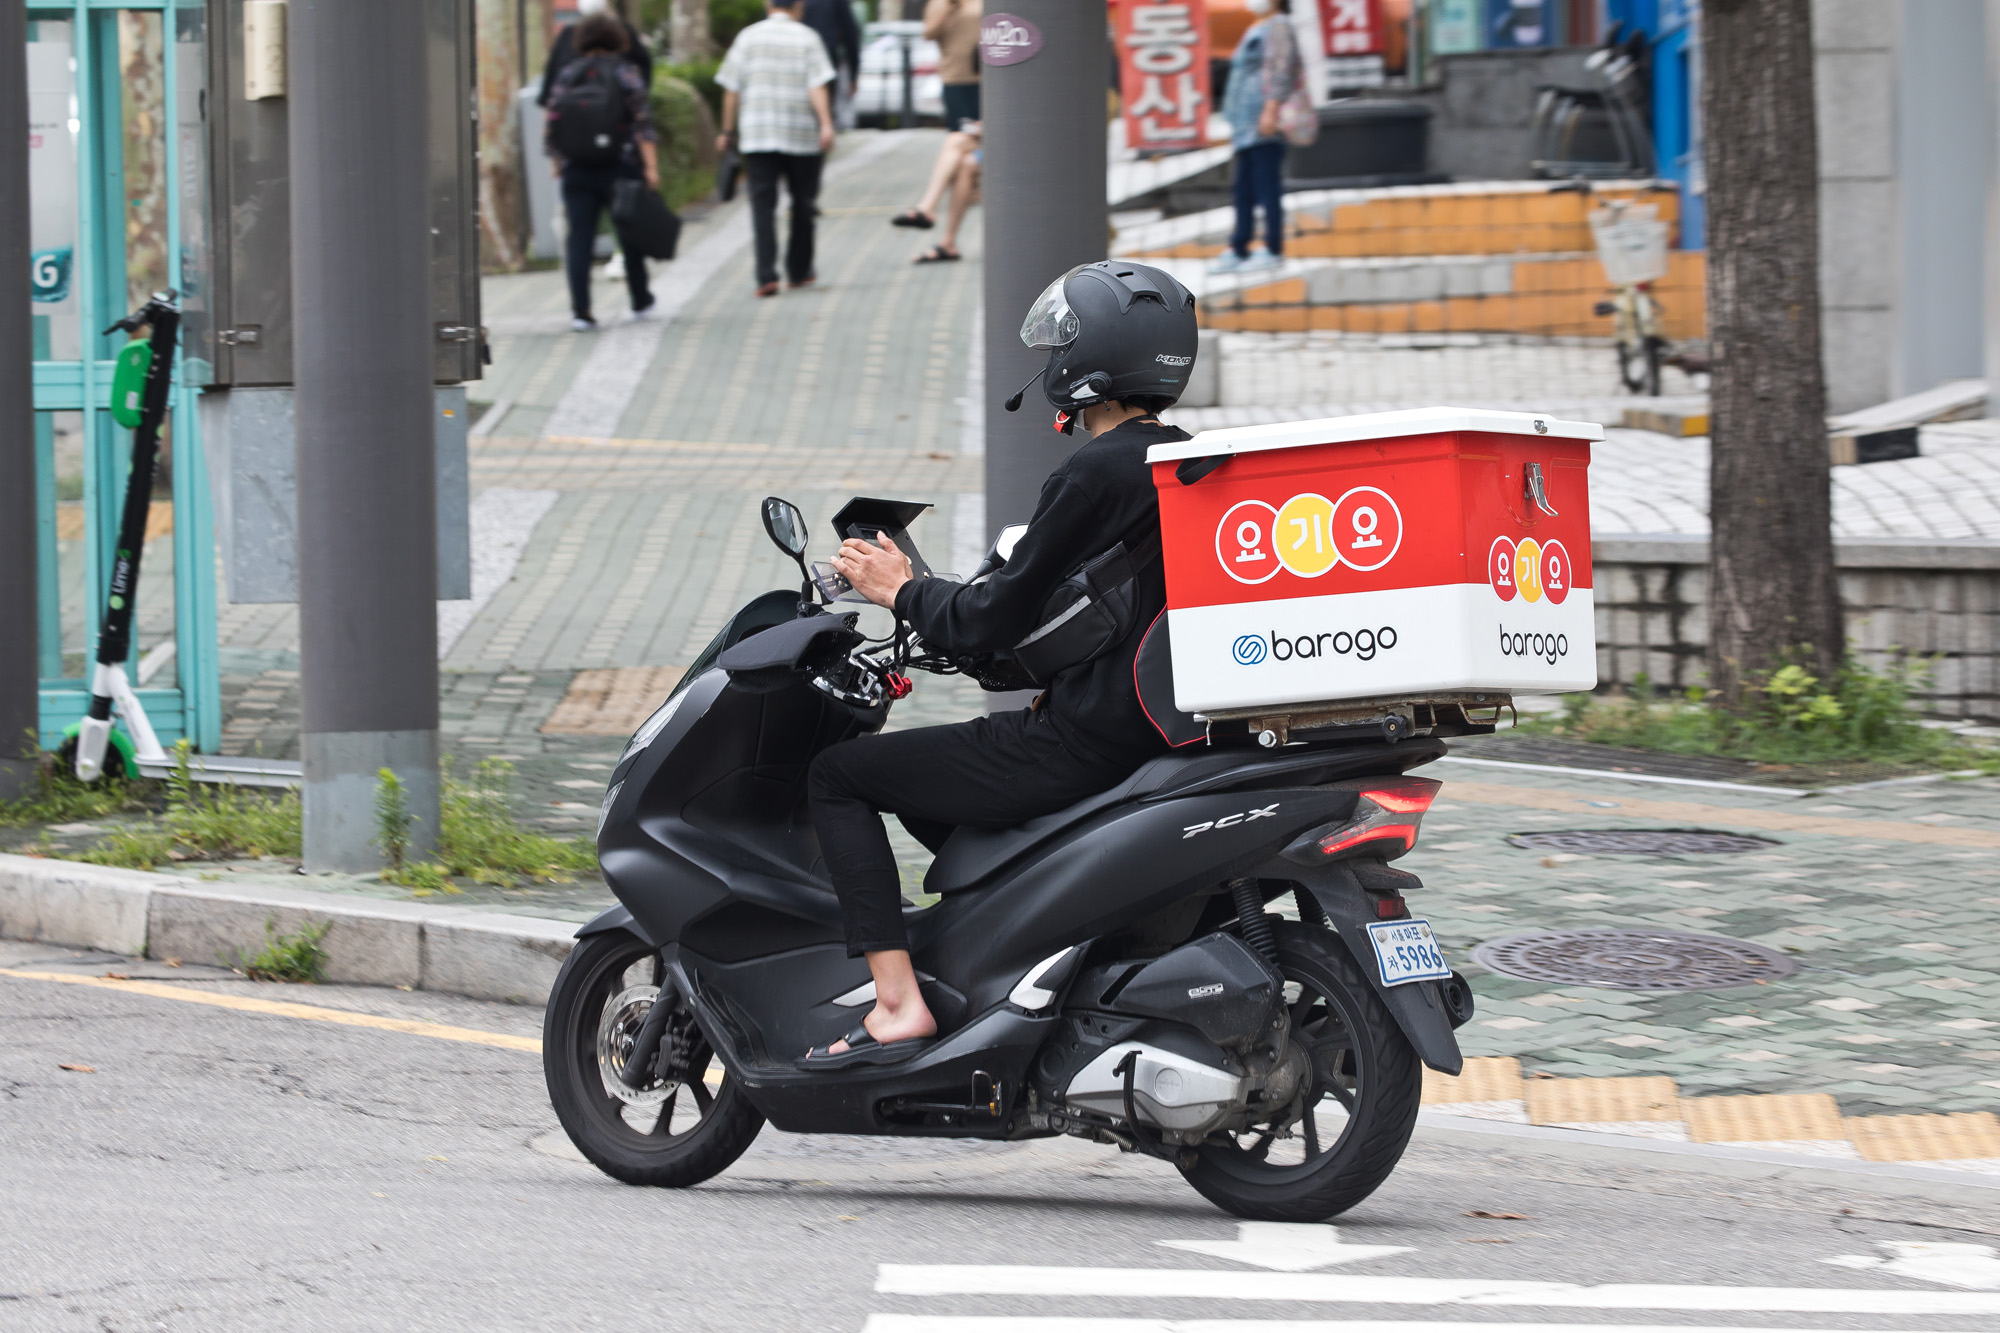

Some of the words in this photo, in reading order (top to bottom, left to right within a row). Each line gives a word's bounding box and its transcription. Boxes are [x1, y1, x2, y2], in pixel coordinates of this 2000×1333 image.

[1125, 2, 1204, 142] 동산
[1232, 503, 1386, 566] 요기요
[1495, 549, 1565, 592] 요기요
[1271, 625, 1398, 662] barogo
[1499, 623, 1568, 666] barogo
[1182, 802, 1280, 840] PCX
[1403, 926, 1422, 941] 마포
[1387, 955, 1400, 972] 차
[1395, 943, 1443, 972] 5986
